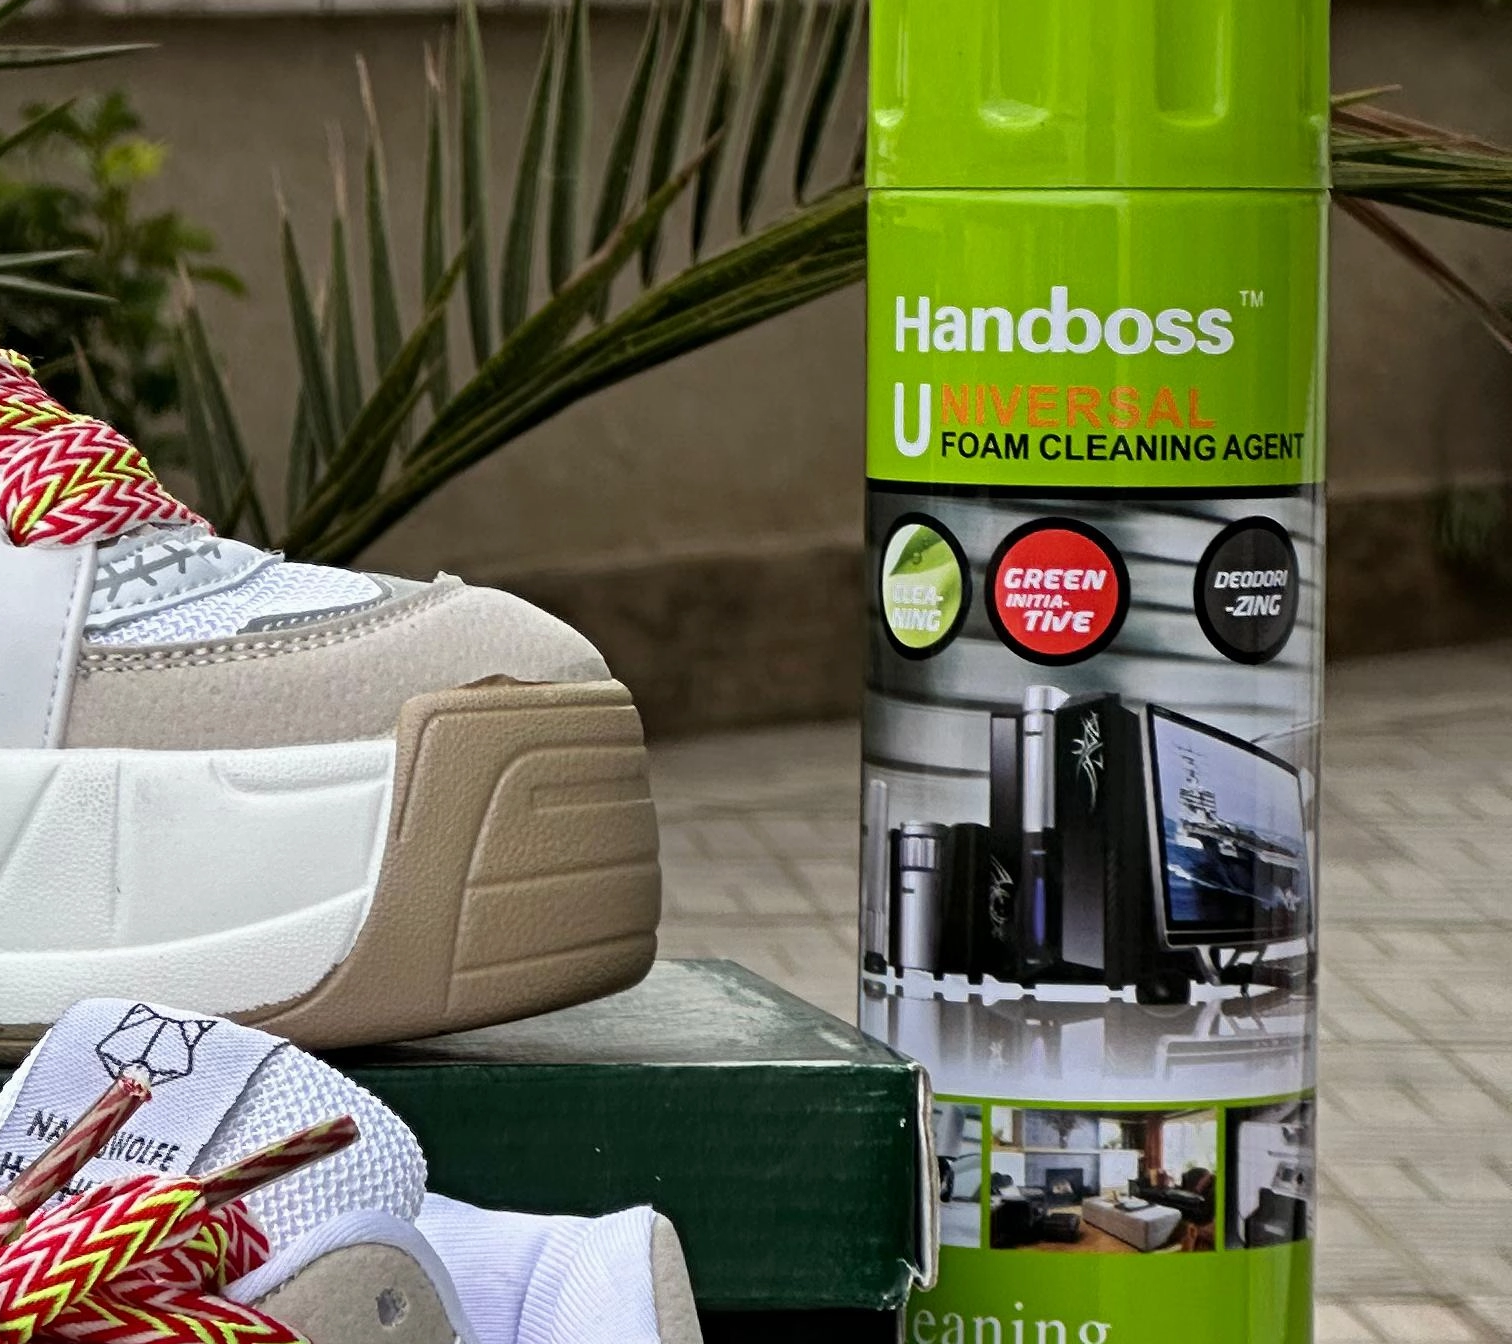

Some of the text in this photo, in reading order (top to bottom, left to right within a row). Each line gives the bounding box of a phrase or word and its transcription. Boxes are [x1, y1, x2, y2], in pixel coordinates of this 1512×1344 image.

[894, 285, 1236, 355] Handboss
[941, 431, 1305, 462] FOAM CLEANING AGENT
[1004, 567, 1107, 591] GREEN
[1214, 570, 1288, 589] DEODORI
[1005, 593, 1070, 609] INITIA-
[1225, 594, 1282, 617] -ZING
[891, 607, 942, 632] NING
[1023, 610, 1095, 633] TIVE
